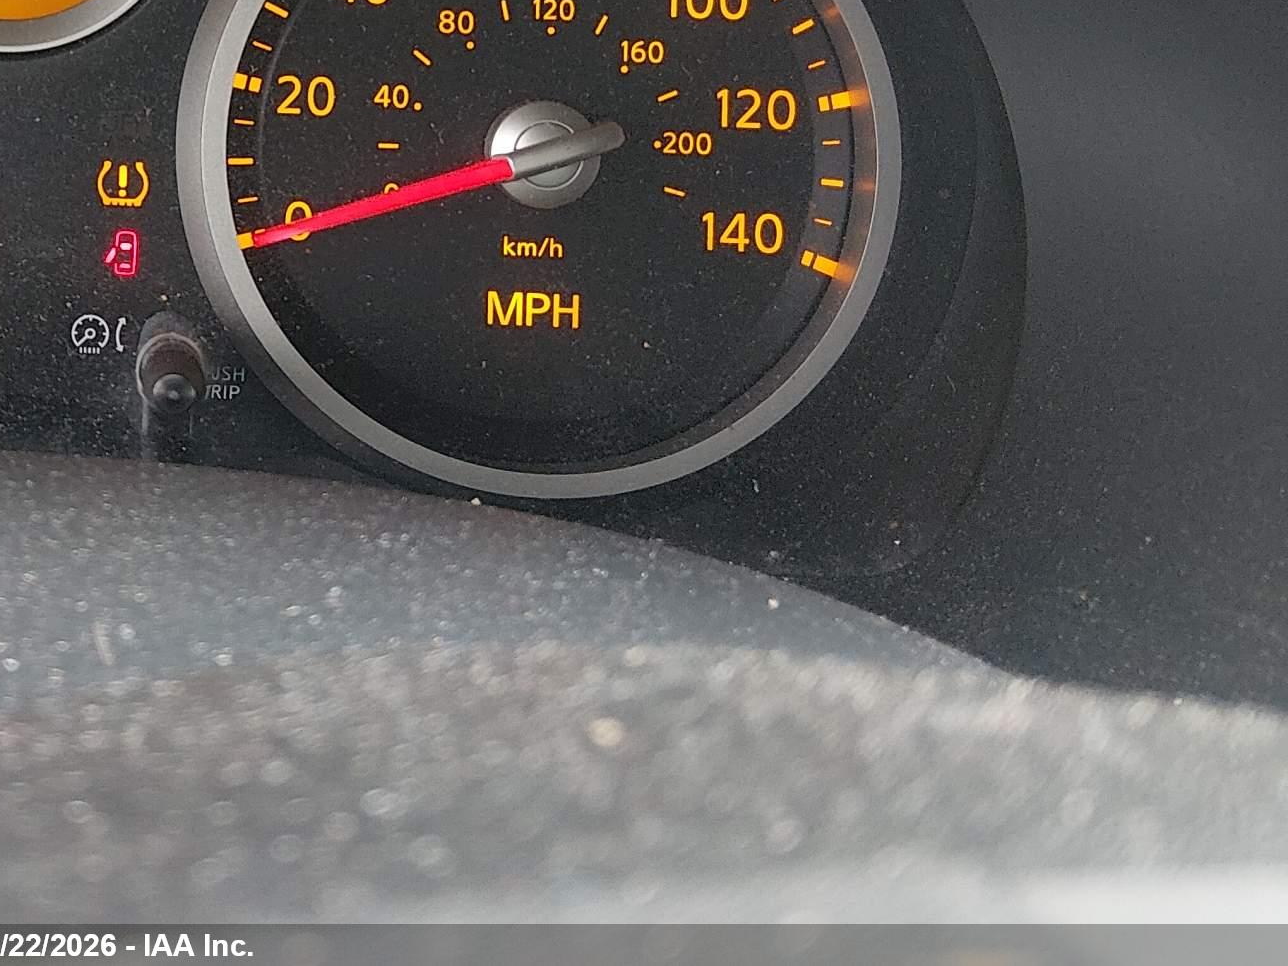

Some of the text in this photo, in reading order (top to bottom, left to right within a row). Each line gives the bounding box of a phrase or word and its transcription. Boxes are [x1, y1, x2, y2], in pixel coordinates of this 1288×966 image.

[438, 9, 475, 35] 80
[620, 40, 665, 64] 160
[276, 75, 337, 117] 20
[373, 84, 410, 109] 40
[715, 88, 797, 131] 120
[662, 131, 713, 156] 200
[701, 211, 784, 255] 140
[502, 235, 564, 259] km/h
[487, 289, 581, 330] MPH
[212, 366, 245, 382] USH
